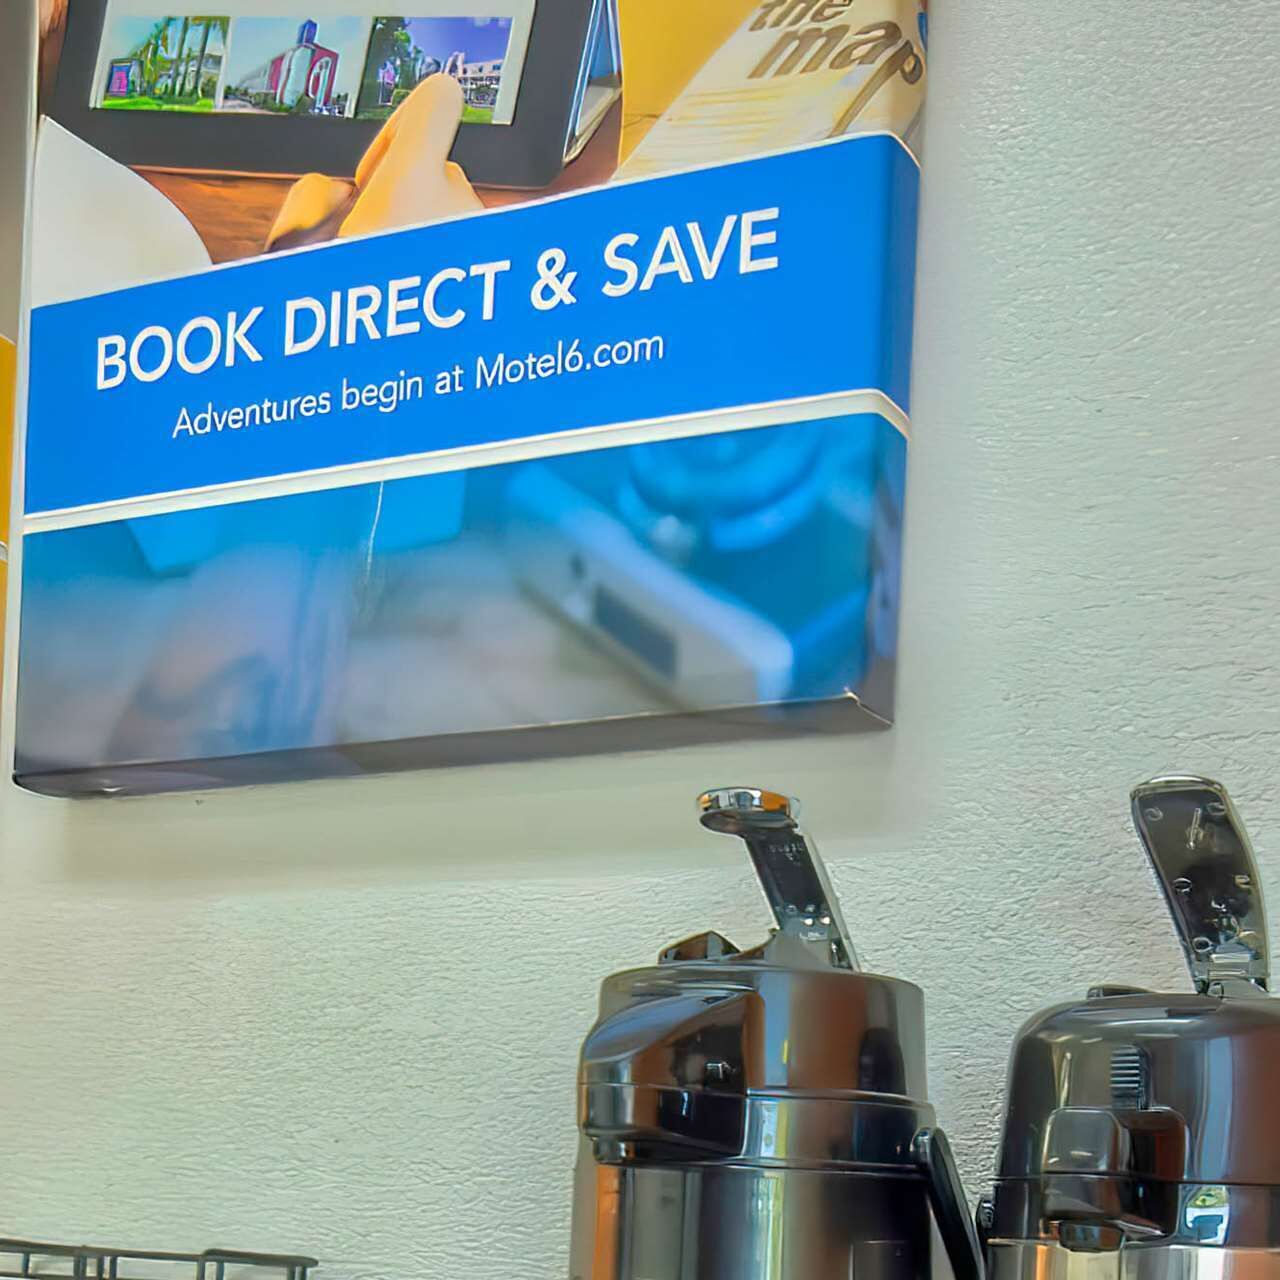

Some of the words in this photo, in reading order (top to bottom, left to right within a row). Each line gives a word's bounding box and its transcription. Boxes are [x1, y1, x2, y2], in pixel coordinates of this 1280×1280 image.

[747, 20, 923, 139] map
[96, 304, 265, 391] BOOK
[285, 258, 510, 356] DIRECT
[530, 247, 578, 312] &
[601, 206, 781, 298] SAVE
[173, 383, 332, 438] Adventures
[341, 367, 423, 416] begin
[433, 362, 466, 396] at
[475, 332, 665, 388] Motel6.com
